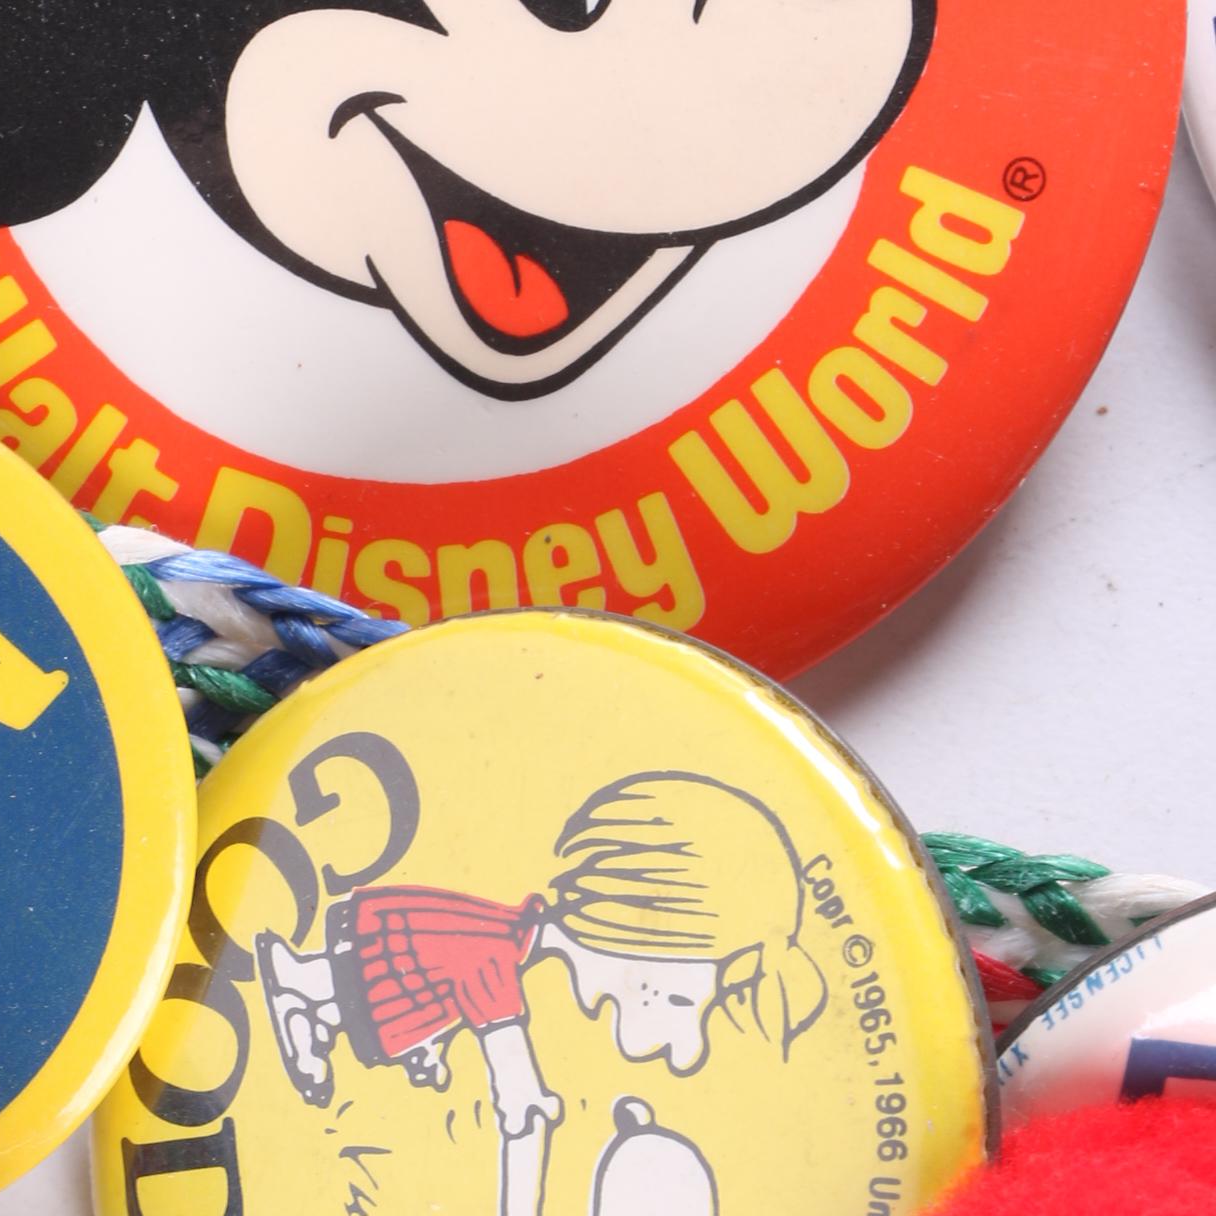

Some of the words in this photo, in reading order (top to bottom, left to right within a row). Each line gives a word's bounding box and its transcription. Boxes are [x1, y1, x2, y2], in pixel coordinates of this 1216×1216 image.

[193, 465, 705, 632] Disney
[667, 165, 1026, 554] World
[802, 854, 854, 929] Copr
[874, 1071, 909, 1162] 1966
